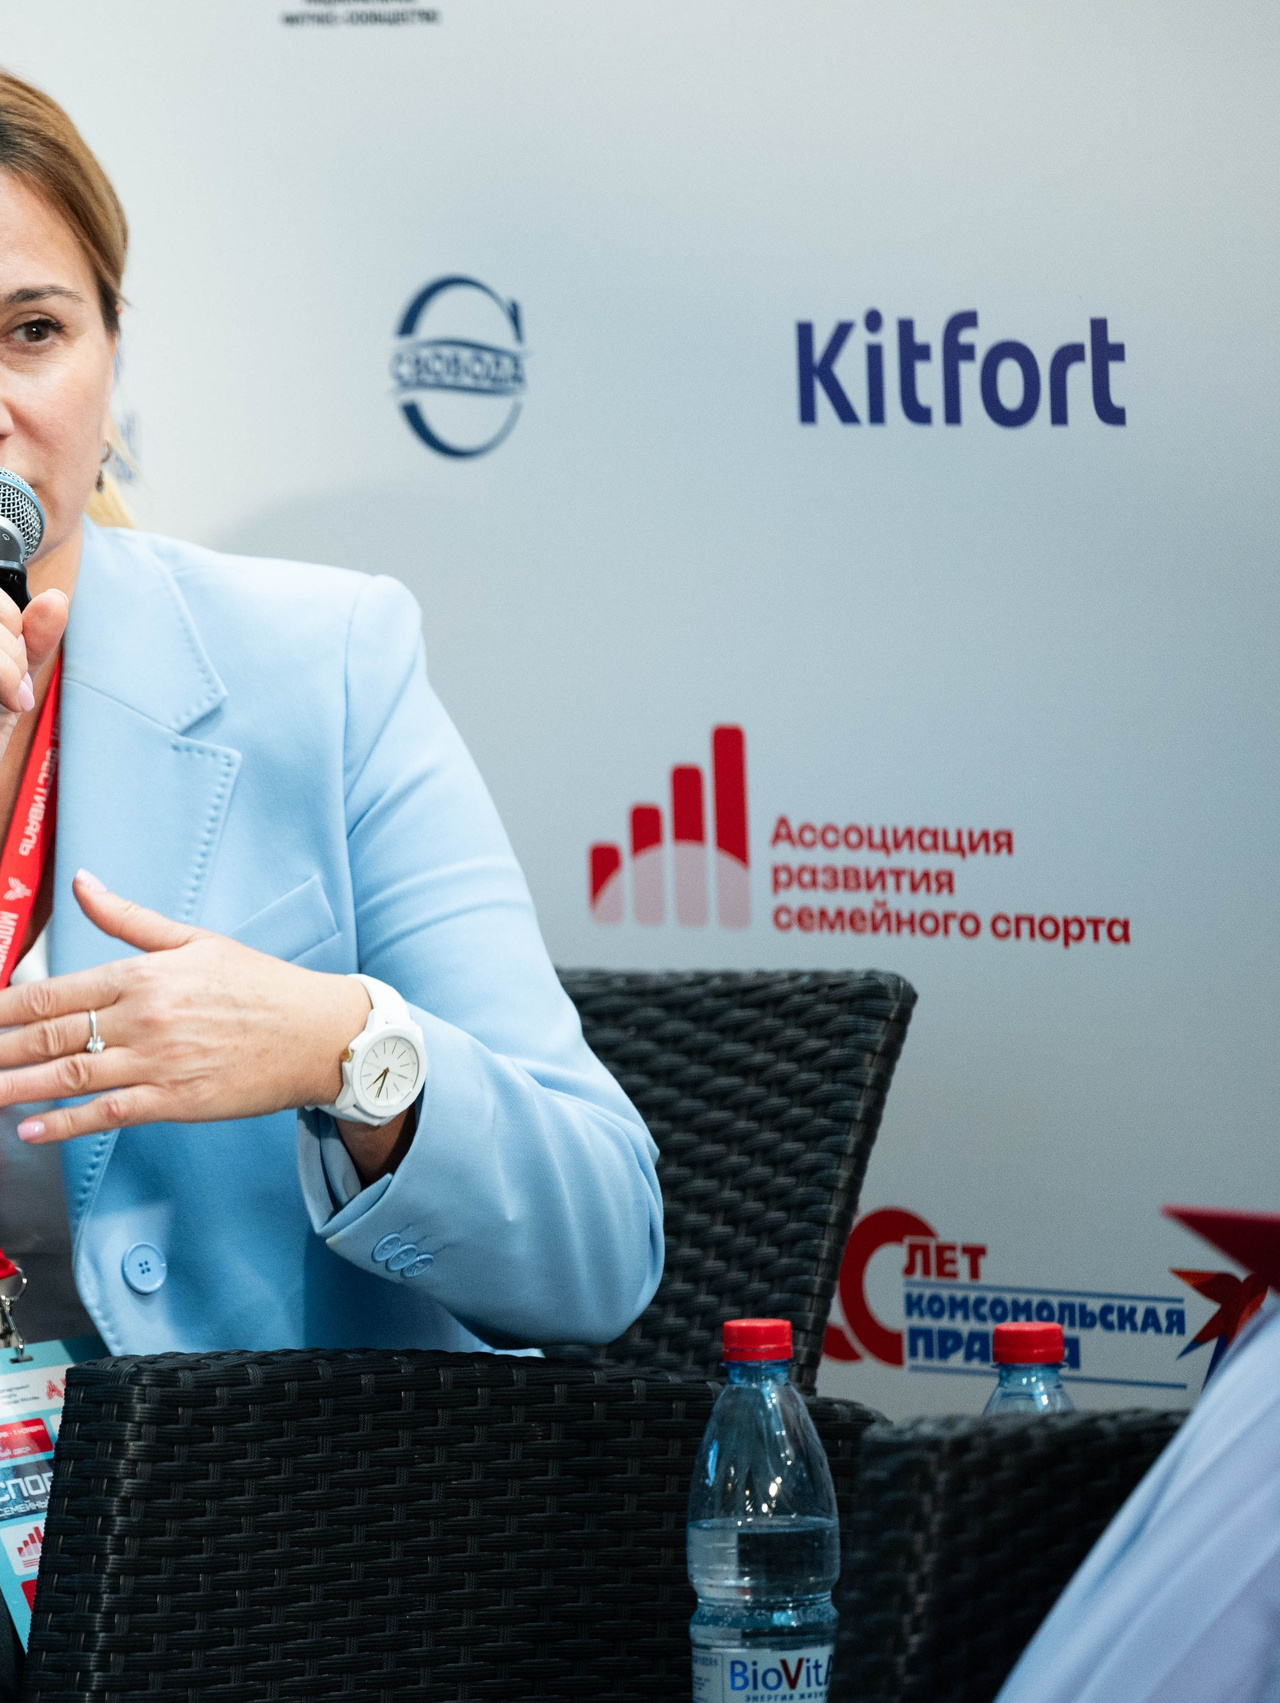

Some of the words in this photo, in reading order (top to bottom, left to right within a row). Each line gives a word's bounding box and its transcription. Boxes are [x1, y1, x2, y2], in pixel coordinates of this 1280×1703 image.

[795, 307, 1127, 428] Kitfort
[772, 815, 1014, 859] Ассоциация
[773, 863, 955, 896] развития
[773, 898, 981, 938] семейного
[990, 911, 1131, 949] спорта
[903, 1243, 987, 1281] ЛЕТ
[904, 1292, 1186, 1335] КОМСОМОЛЬСКАЯ
[907, 1327, 1081, 1370] ПРАА
